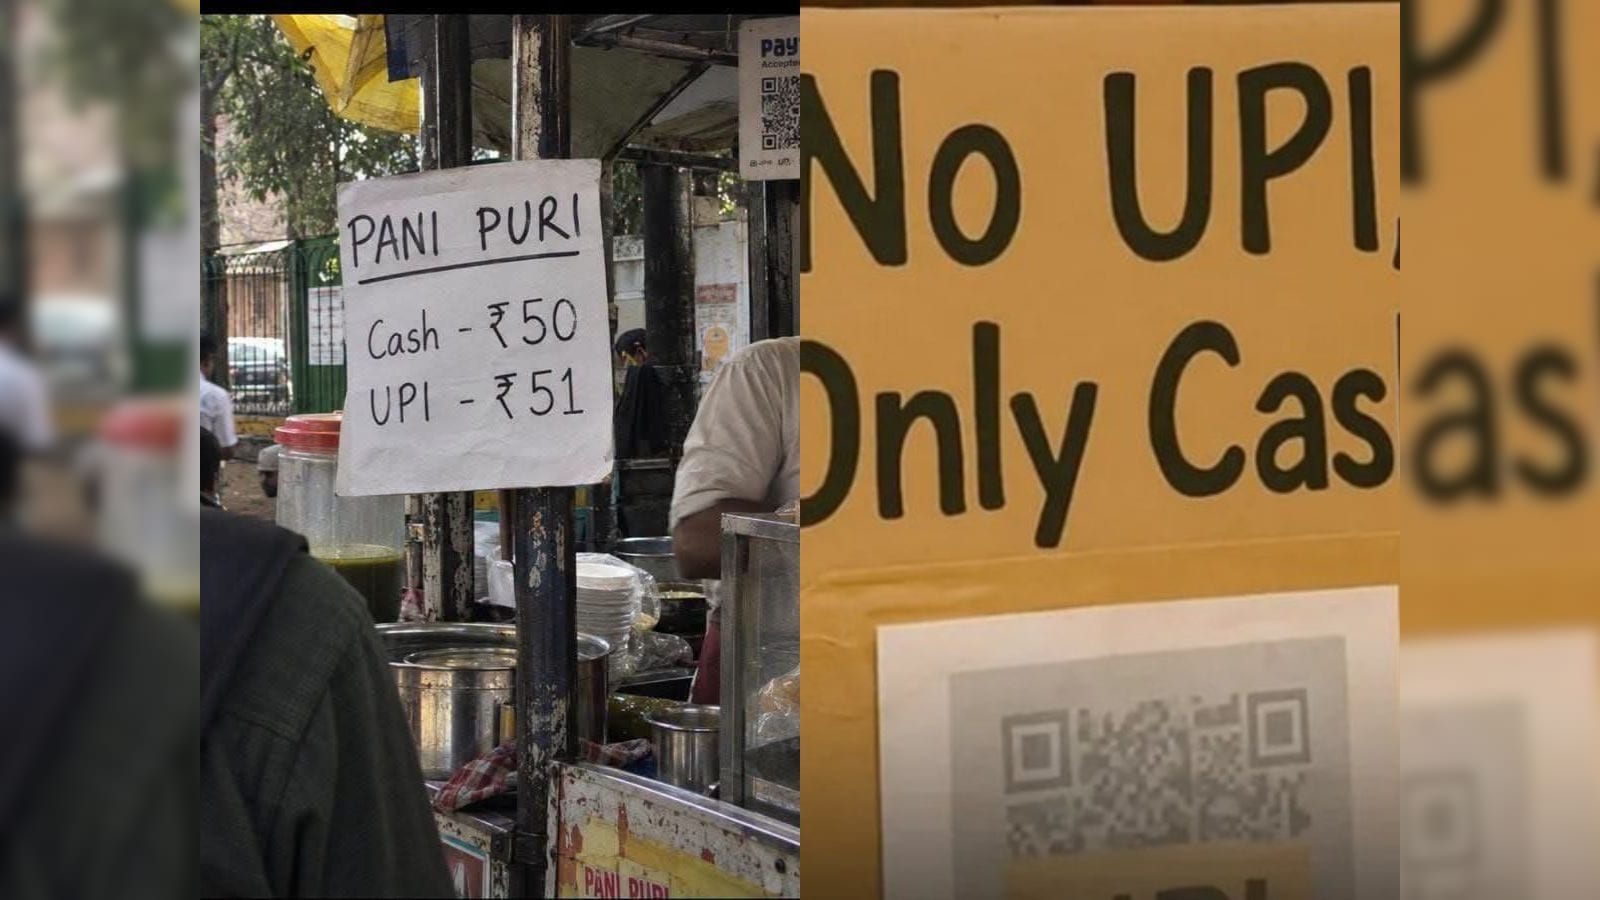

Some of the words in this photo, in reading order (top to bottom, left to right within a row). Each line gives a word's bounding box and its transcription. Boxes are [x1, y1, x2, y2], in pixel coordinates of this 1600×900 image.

[761, 37, 800, 58] Pay
[761, 60, 800, 69] Accepte
[800, 69, 1022, 273] No
[347, 211, 439, 268] PANI
[475, 192, 581, 251] PURI
[367, 308, 440, 360] Cash
[487, 298, 578, 349] ₹50
[370, 381, 430, 426] UPI
[494, 367, 584, 420] ₹51
[800, 320, 1099, 550] Only
[1148, 312, 1400, 498] Cas
[584, 866, 620, 898] PANI
